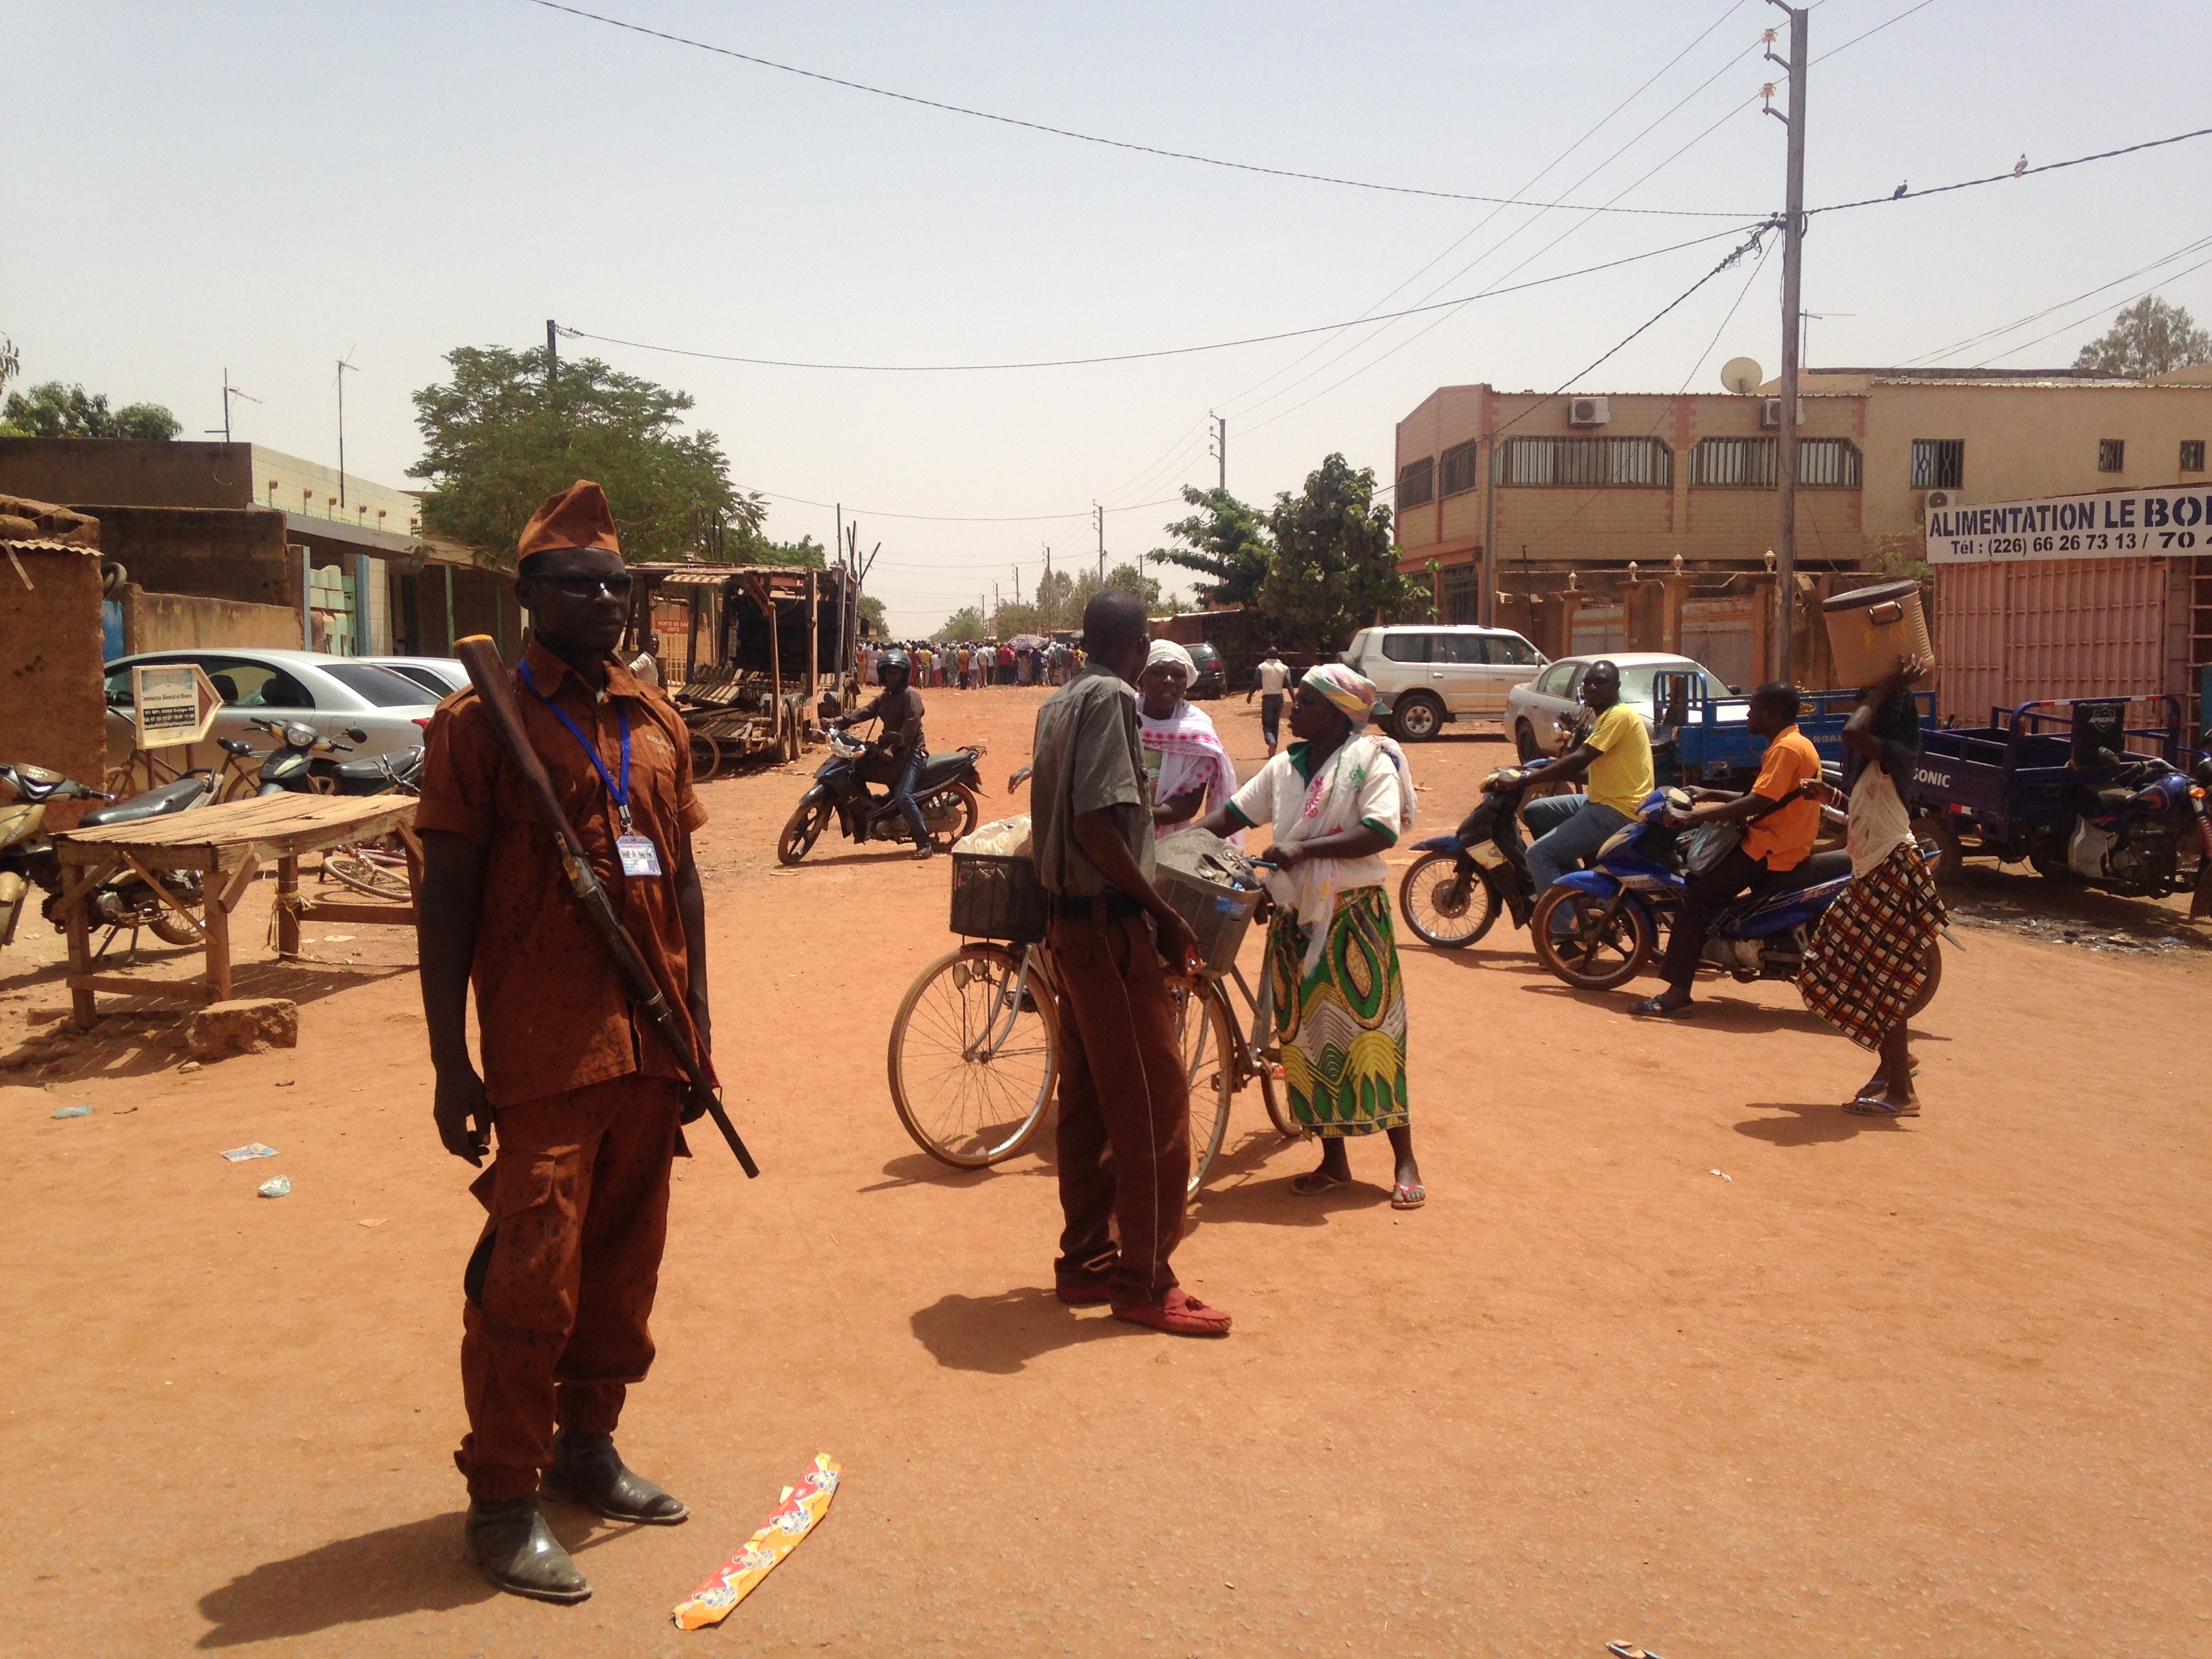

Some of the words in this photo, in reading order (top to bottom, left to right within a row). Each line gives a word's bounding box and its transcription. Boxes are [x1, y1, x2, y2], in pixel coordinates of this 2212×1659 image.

[1929, 501, 2095, 537] ALIMENTATION
[2104, 499, 2135, 529] LE
[1951, 539, 1973, 554] Tél
[1988, 537, 2027, 557] (226)
[2033, 536, 2053, 552] 66
[2059, 535, 2081, 551] 26
[2086, 533, 2108, 550] 73
[2115, 532, 2137, 549] 13
[2158, 531, 2196, 548] 70
